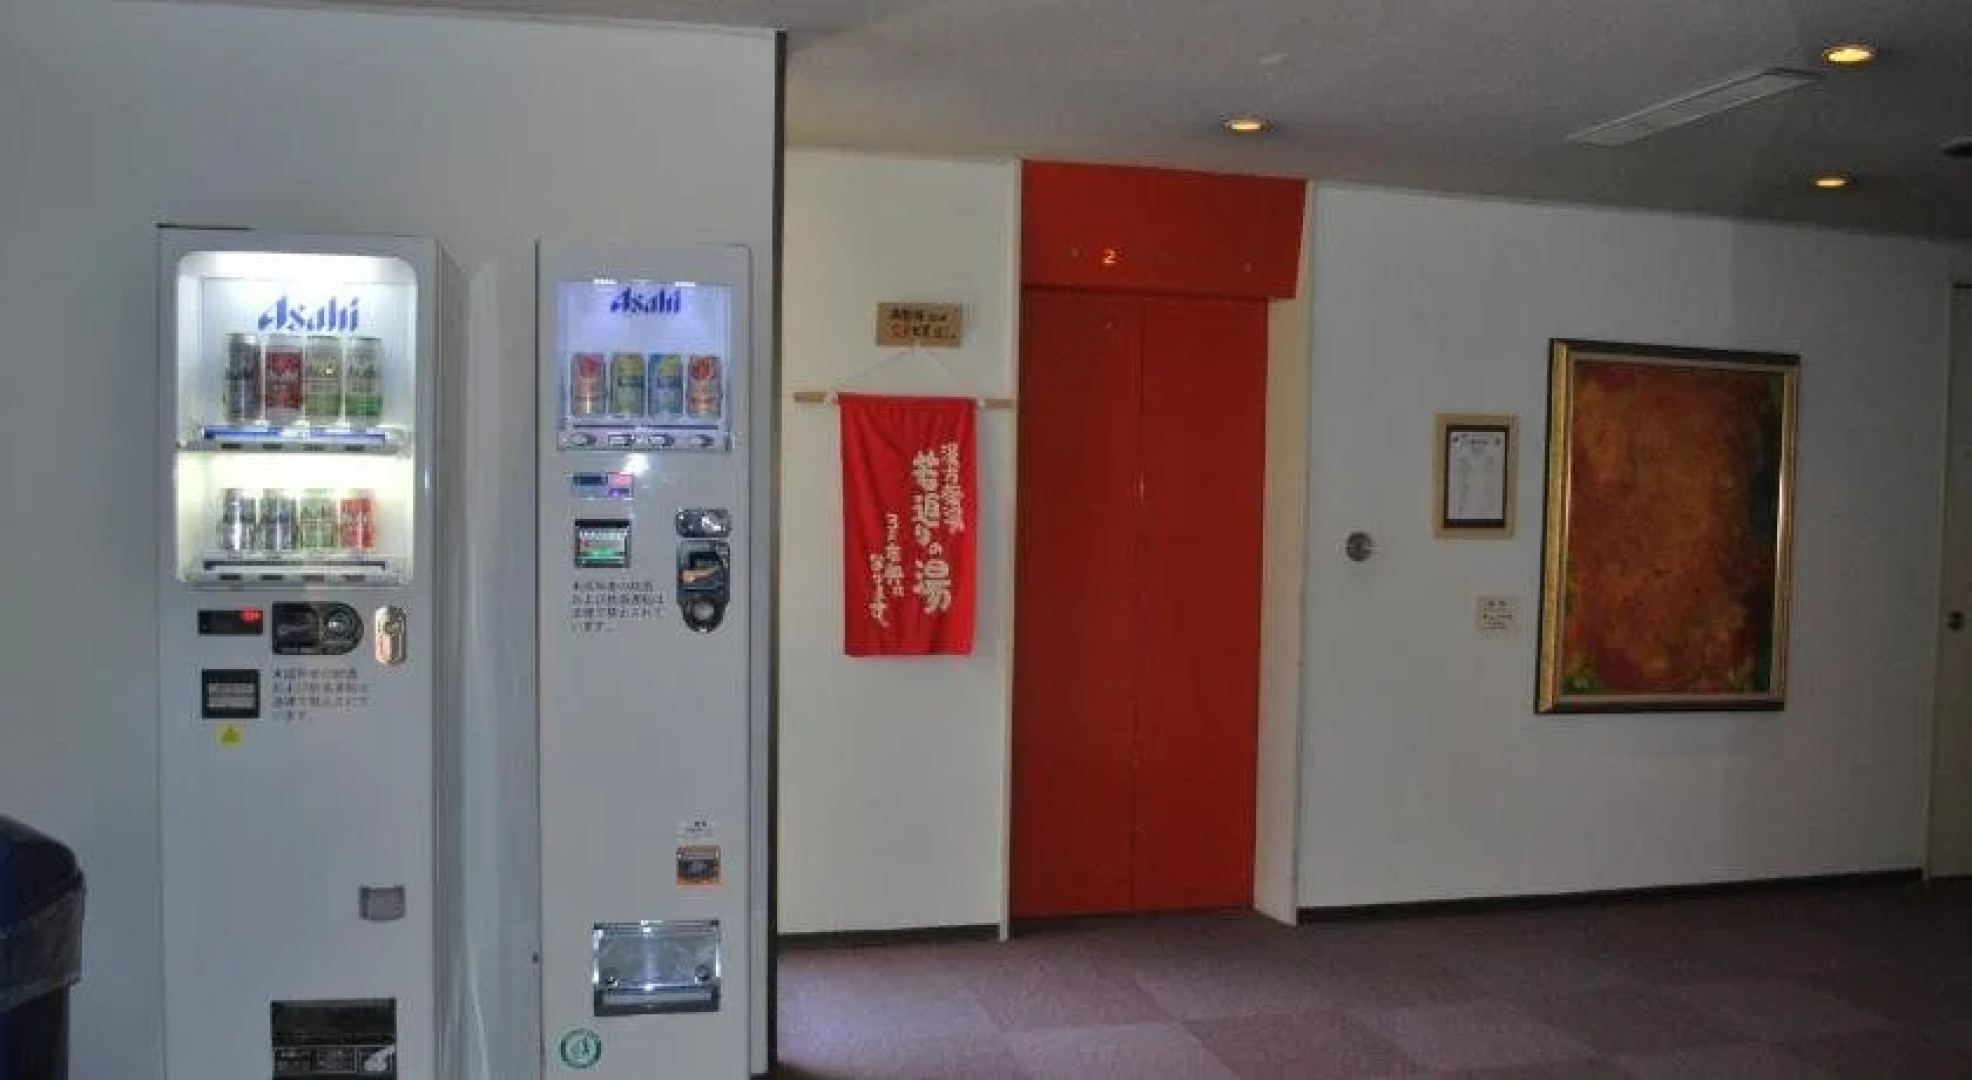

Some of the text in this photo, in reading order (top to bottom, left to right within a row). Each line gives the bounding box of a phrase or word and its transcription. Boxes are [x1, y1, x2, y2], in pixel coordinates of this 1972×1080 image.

[1103, 249, 1115, 264] 2
[257, 296, 360, 332] Asahi
[610, 287, 682, 315] Asahi
